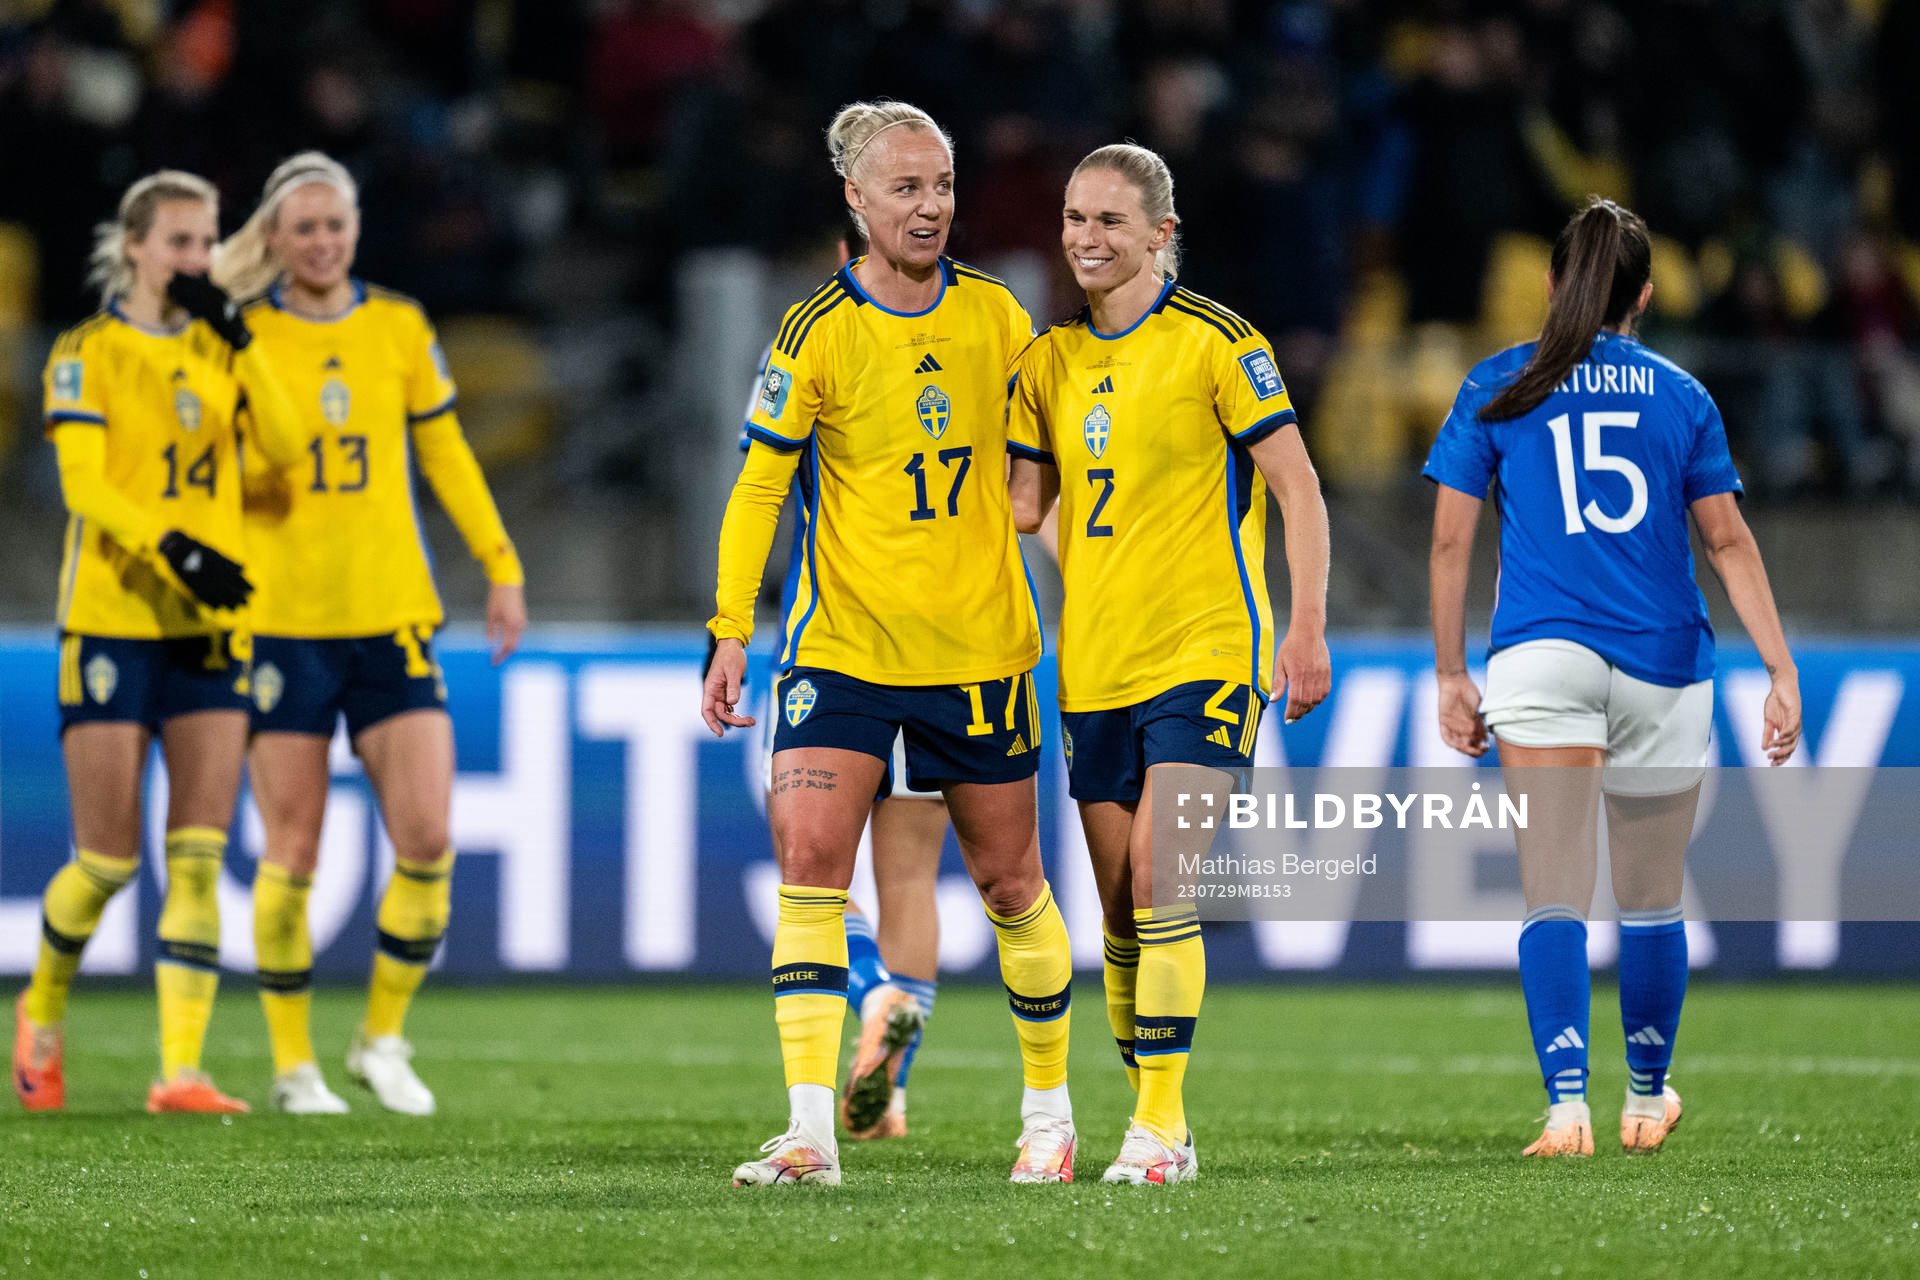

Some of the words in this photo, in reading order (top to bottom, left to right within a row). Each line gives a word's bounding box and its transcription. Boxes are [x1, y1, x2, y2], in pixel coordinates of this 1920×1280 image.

[162, 442, 217, 498] 14
[308, 435, 369, 493] 13
[904, 446, 972, 521] 17
[1547, 411, 1648, 535] 15
[1087, 468, 1115, 538] 2
[959, 674, 1015, 736] 17
[1204, 681, 1239, 725] 2
